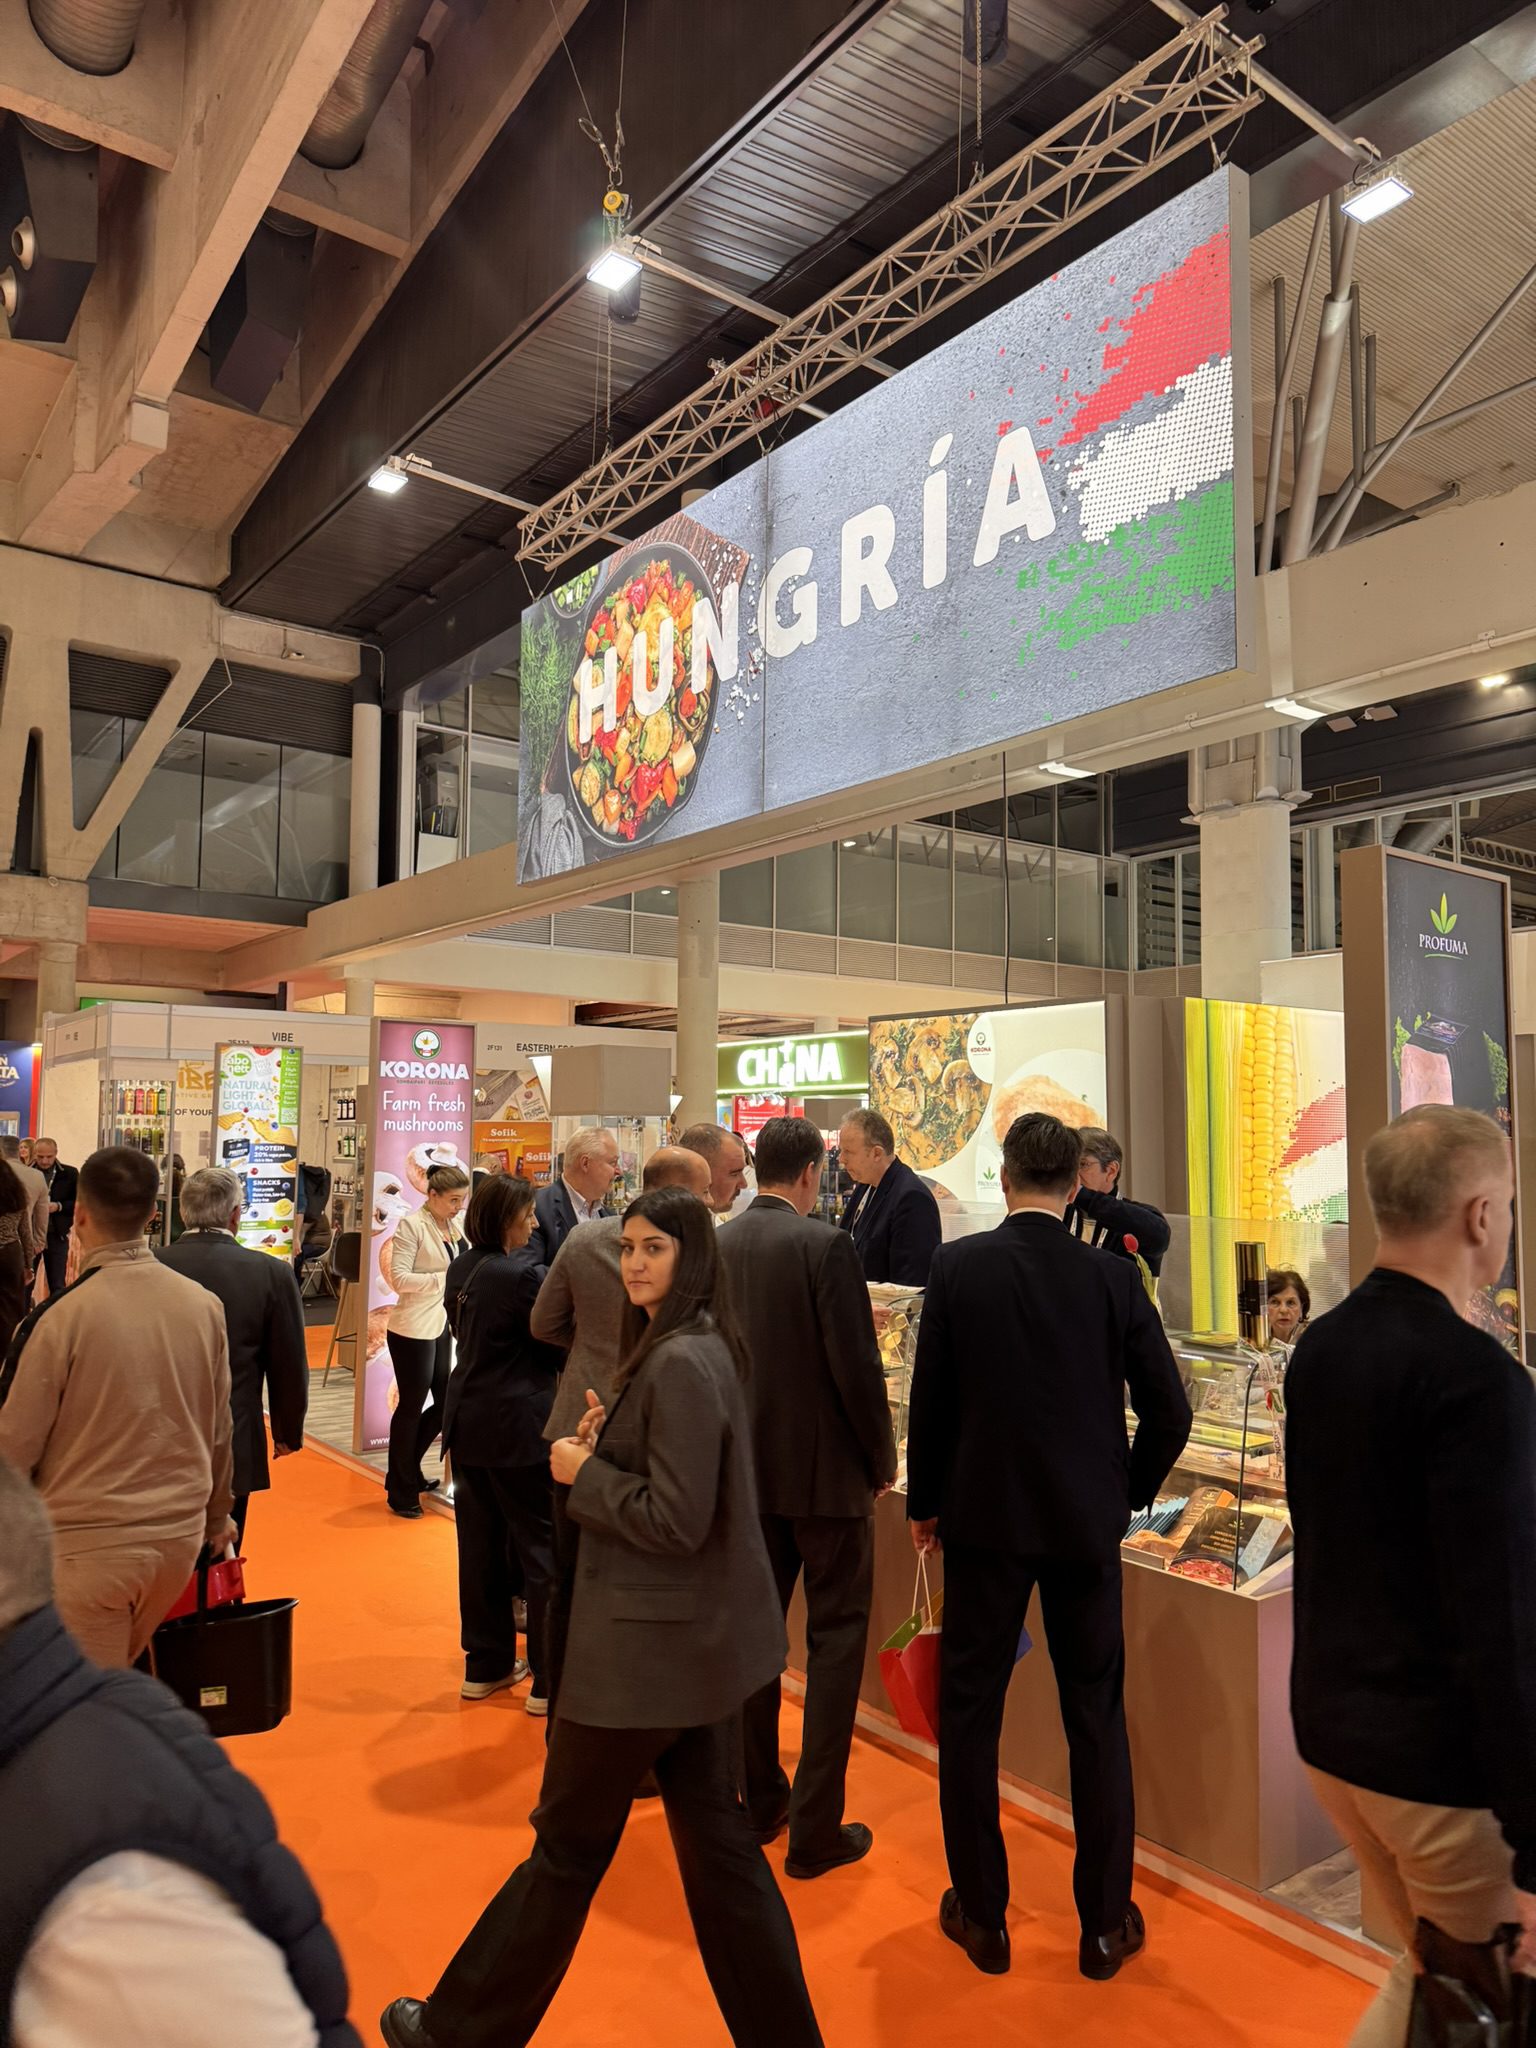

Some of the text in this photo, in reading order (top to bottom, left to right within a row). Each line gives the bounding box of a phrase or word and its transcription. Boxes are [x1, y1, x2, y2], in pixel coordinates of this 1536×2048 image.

[578, 426, 1057, 743] HUNGRÍA
[1419, 933, 1469, 955] PROFUMA
[272, 1032, 294, 1042] VIBE
[516, 1043, 555, 1052] EASTERN
[380, 1060, 469, 1080] KORONA
[223, 1091, 256, 1100] LIGHT.
[383, 1090, 421, 1111] Farm
[428, 1092, 466, 1112] fresh
[174, 1108, 188, 1116] OF
[383, 1113, 464, 1132] mushrooms
[490, 1128, 517, 1137] Sofik
